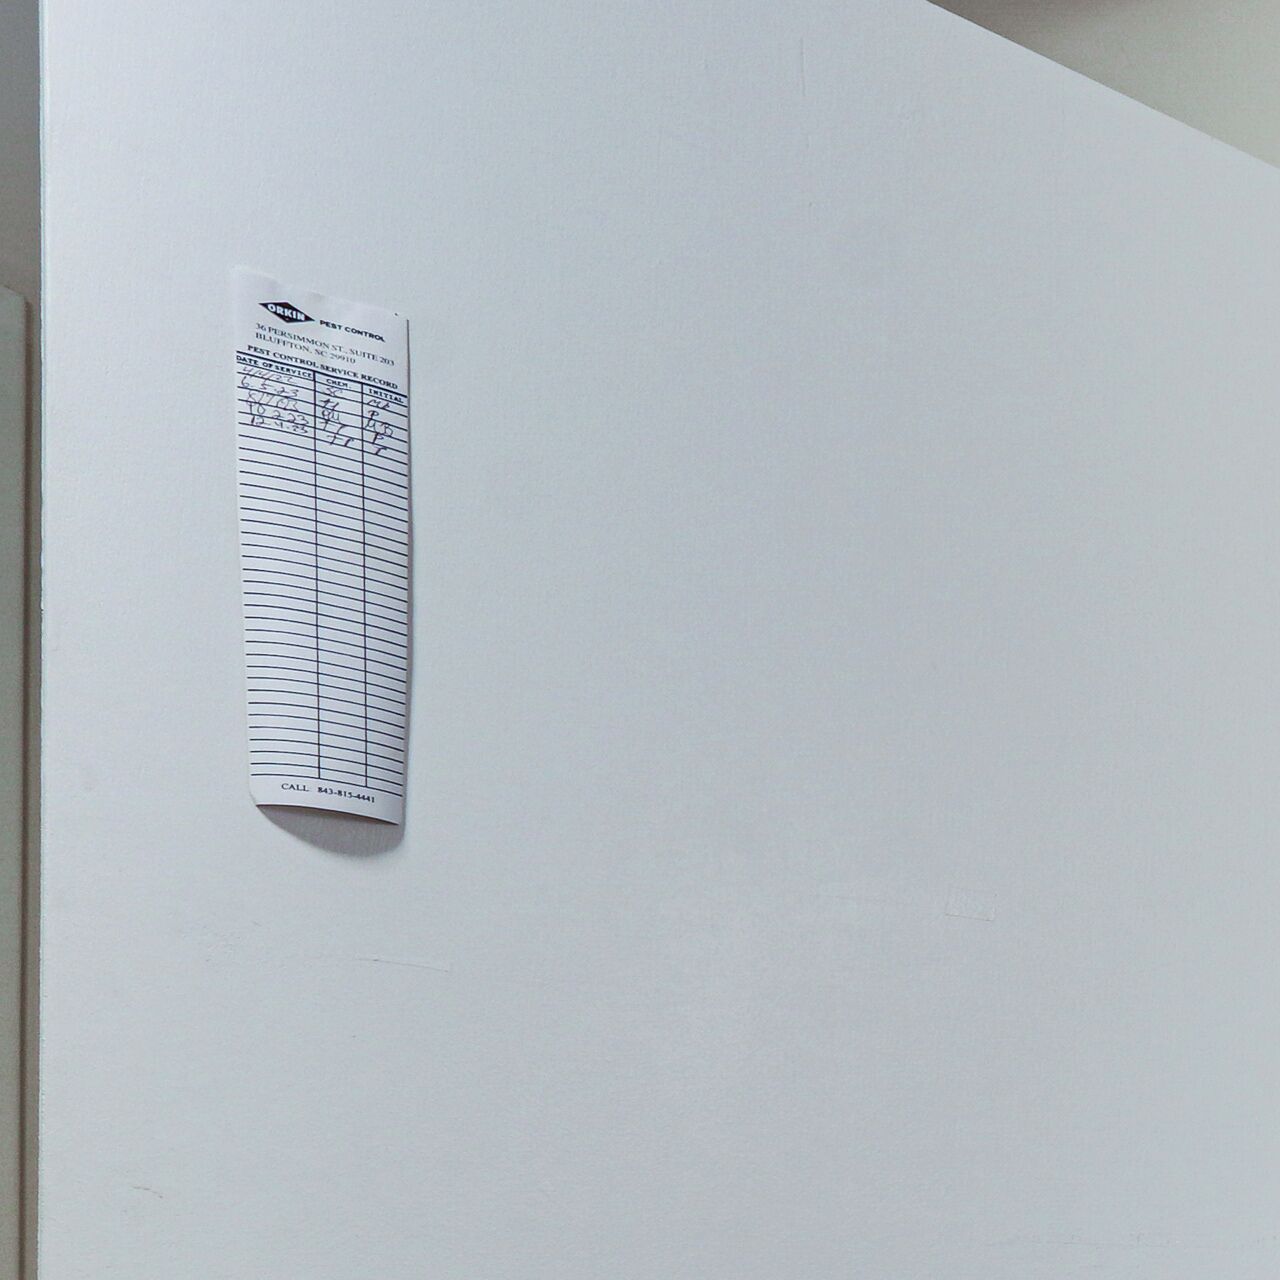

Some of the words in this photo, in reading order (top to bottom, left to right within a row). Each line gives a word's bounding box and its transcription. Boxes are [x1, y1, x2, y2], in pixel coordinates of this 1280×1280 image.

[267, 303, 305, 321] ORKIN
[320, 319, 342, 331] PEST
[344, 326, 386, 342] CONTROL
[268, 326, 330, 349] PERSIMMON
[349, 348, 378, 362] SUITE
[236, 354, 259, 366] DATE
[262, 361, 274, 369] OF
[274, 364, 313, 378] SERVICE
[247, 344, 271, 356] PEST
[273, 351, 319, 369] CONTROL
[320, 363, 359, 379] SERVICE
[361, 373, 398, 390] RECORD
[368, 388, 404, 404] INITIAL
[281, 783, 310, 792] CALL
[317, 786, 375, 803] 843-815-4441
